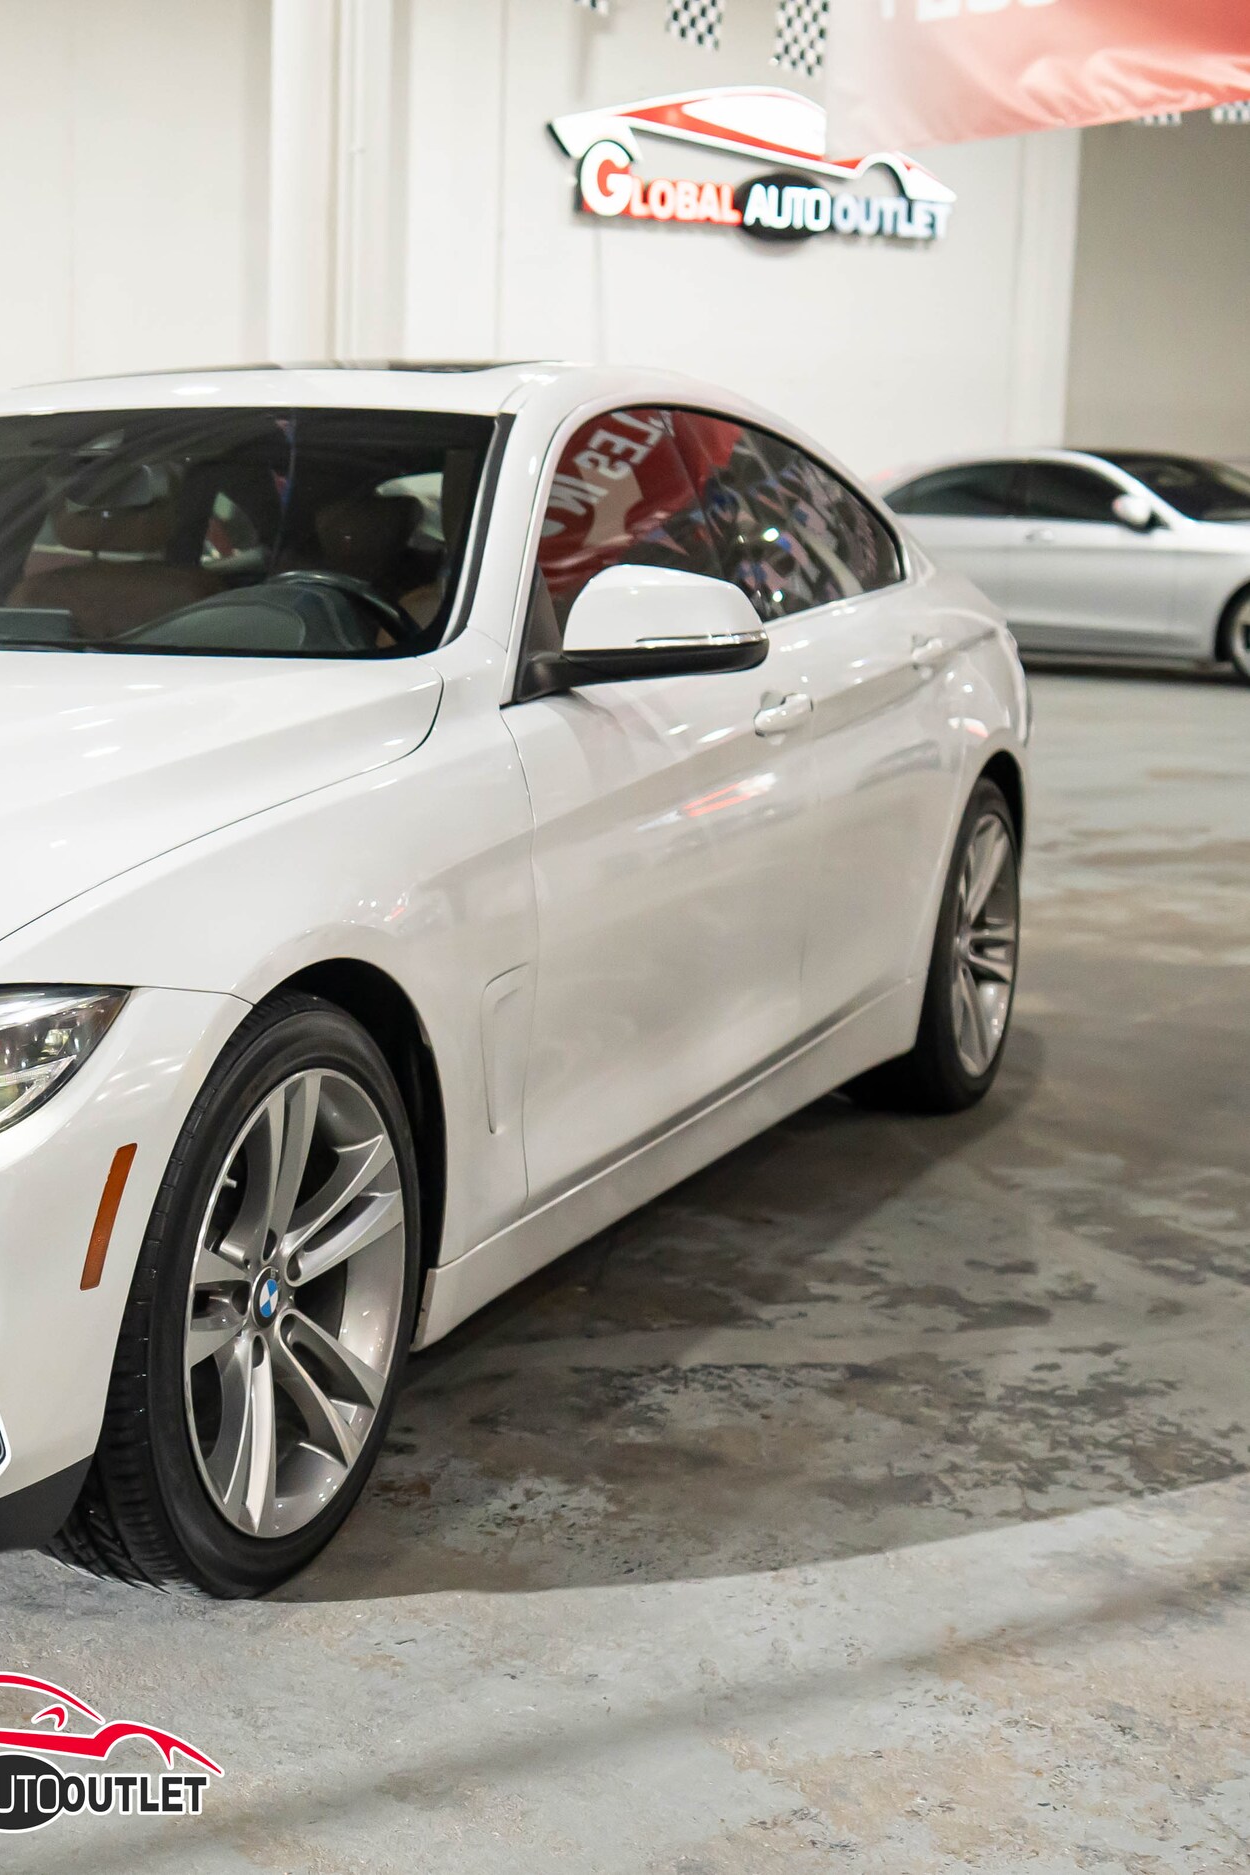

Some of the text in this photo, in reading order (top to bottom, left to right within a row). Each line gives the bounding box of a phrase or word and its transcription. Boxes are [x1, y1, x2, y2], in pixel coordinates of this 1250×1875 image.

[580, 140, 950, 238] GLOBAL AUTO OUTLET
